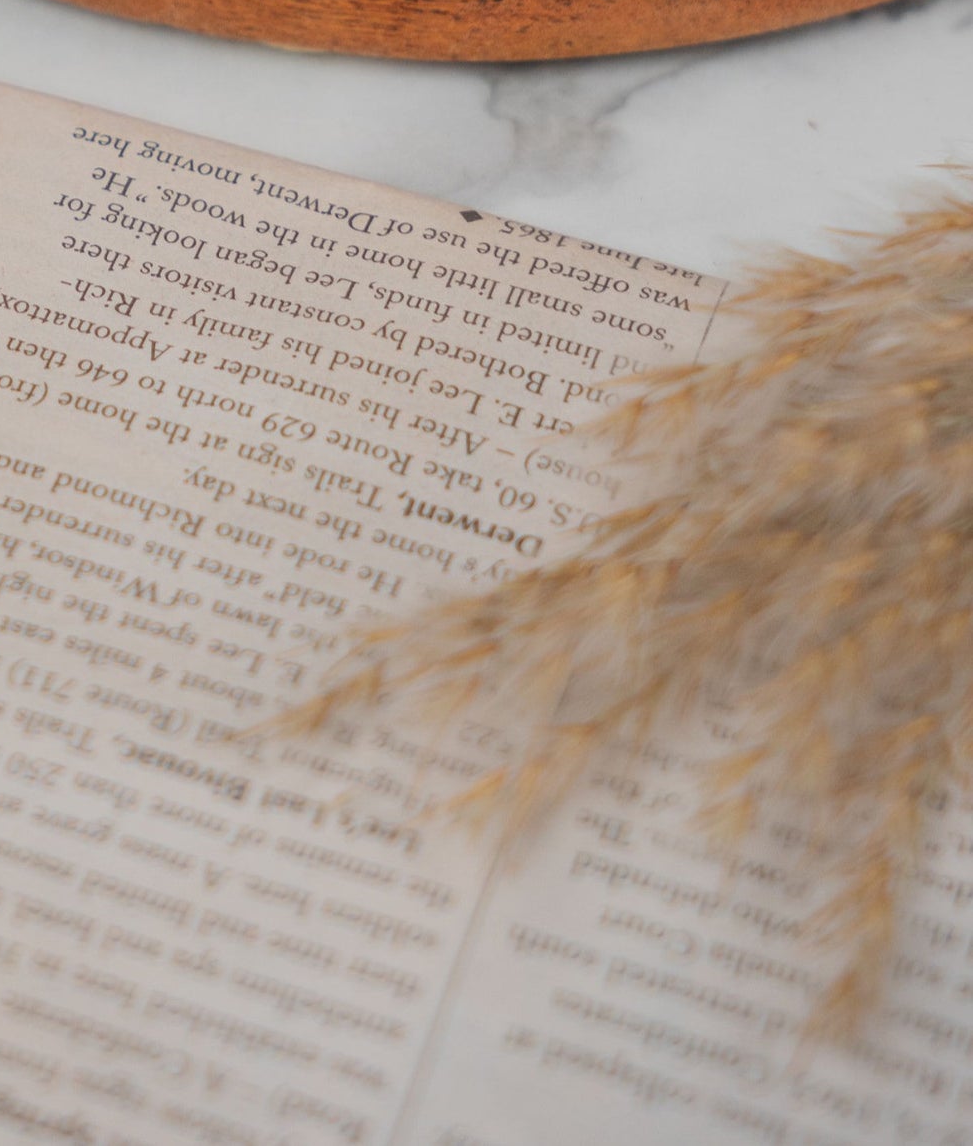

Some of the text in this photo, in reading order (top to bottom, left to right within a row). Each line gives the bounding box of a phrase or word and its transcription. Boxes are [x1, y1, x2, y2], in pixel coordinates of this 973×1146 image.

[91, 166, 135, 198] He
[72, 126, 690, 312] was offered the use of Derwent, moving here
[255, 219, 299, 247] the
[309, 234, 338, 258] in
[344, 244, 423, 279] home
[495, 215, 703, 287] late June 1865.
[52, 193, 648, 383] nd limited in funds, Lee began looking for
[60, 278, 139, 317] Rich-
[432, 264, 499, 300] little
[148, 301, 177, 326] in
[504, 284, 583, 317] small
[60, 234, 621, 416] ond. Bothered by constant visitors there
[182, 308, 273, 350] family
[5, 336, 67, 370] then
[178, 348, 207, 365] at
[280, 336, 323, 365] his
[76, 358, 129, 386] 646
[137, 375, 166, 395] to
[213, 357, 350, 405] surrender
[327, 349, 428, 393] joined
[57, 391, 137, 432] home
[176, 384, 254, 418] north
[357, 398, 400, 430] his
[428, 379, 483, 415] Lee
[494, 398, 524, 428] E.
[145, 416, 191, 445] the
[199, 431, 228, 450] at
[260, 412, 317, 441] 629
[407, 414, 487, 456] After
[236, 442, 296, 474] sign
[325, 429, 414, 476] Route
[183, 465, 236, 502] day.
[304, 464, 382, 512] Trails
[422, 460, 483, 493] take
[522, 447, 620, 500] house)
[49, 471, 205, 538] Richmond
[243, 488, 306, 520] next
[493, 478, 537, 511] 60,
[214, 522, 274, 556] into
[314, 511, 362, 541] the
[398, 491, 543, 553] Derwent,
[142, 540, 186, 571] his
[282, 542, 350, 574] rode
[371, 528, 454, 572] home
[29, 541, 158, 604] Windsor,
[192, 556, 263, 586] after
[357, 565, 403, 598] He
[62, 594, 109, 623] the
[162, 587, 202, 607] of
[117, 611, 198, 646] spent
[210, 599, 281, 639] lawn
[62, 634, 143, 671] miles
[289, 622, 339, 653] the
[146, 661, 170, 685] 4
[207, 638, 265, 676] Lee
[274, 657, 305, 686] E.
[177, 668, 264, 711] about
